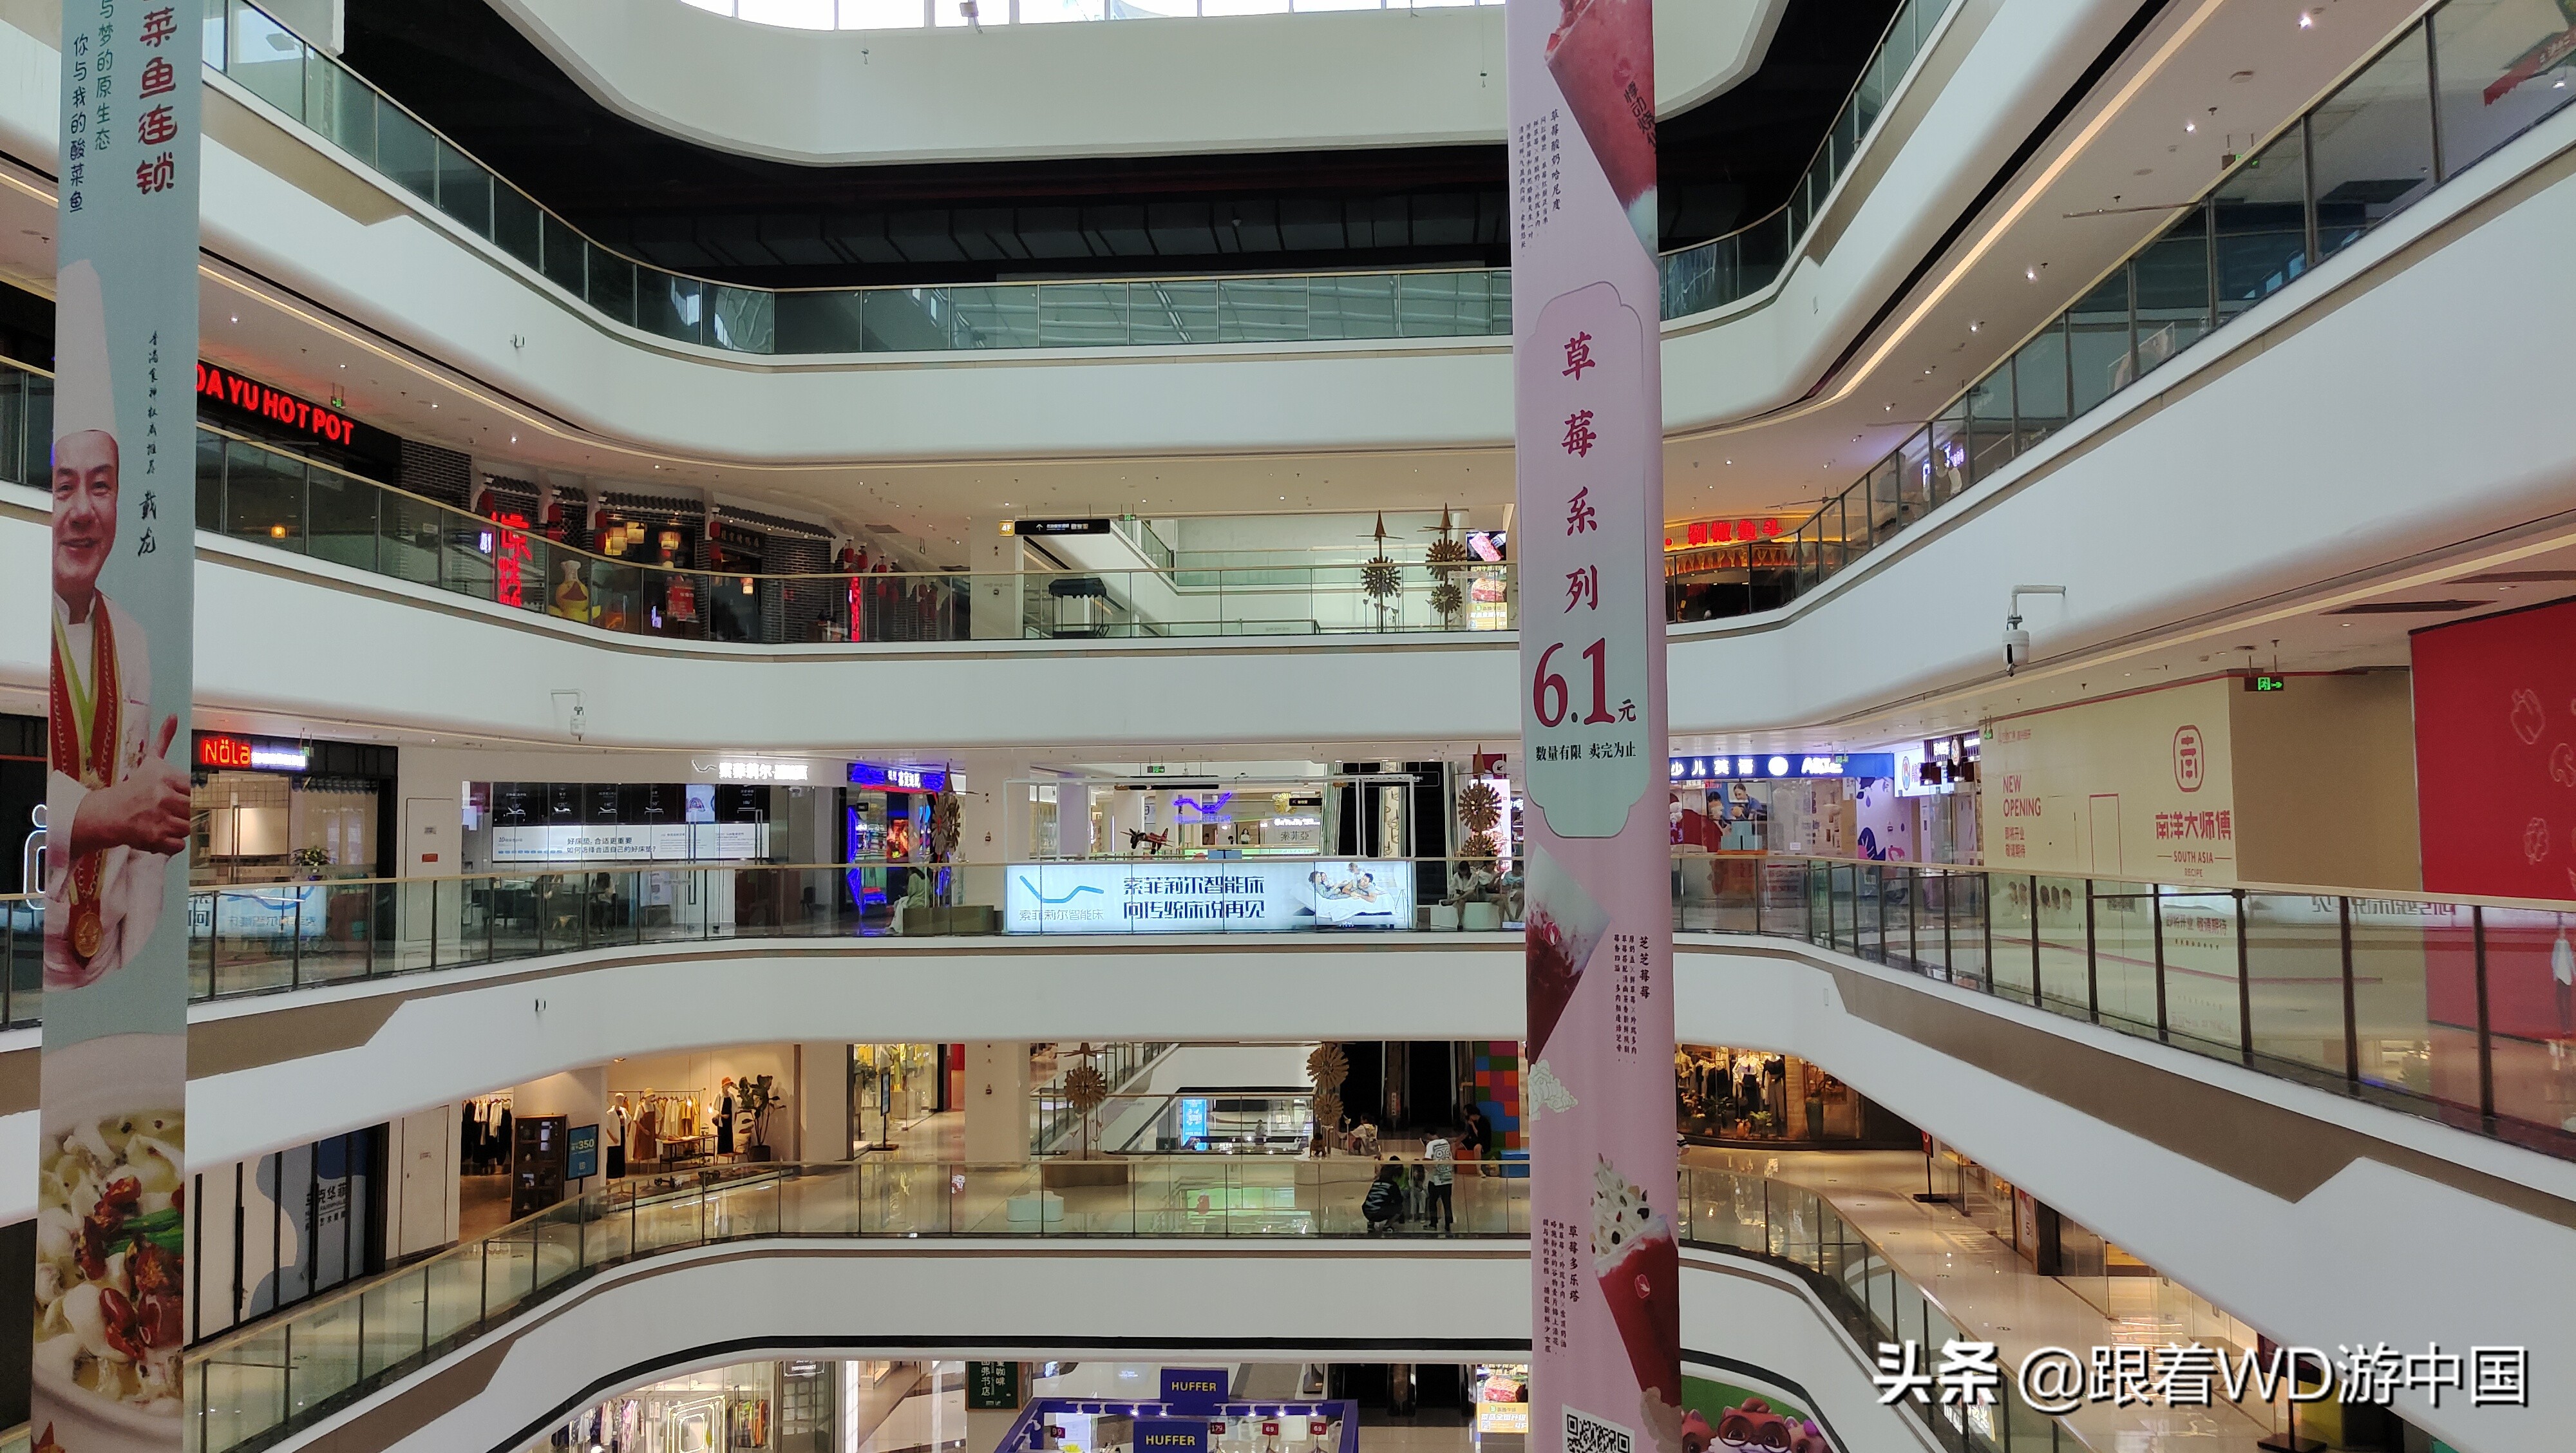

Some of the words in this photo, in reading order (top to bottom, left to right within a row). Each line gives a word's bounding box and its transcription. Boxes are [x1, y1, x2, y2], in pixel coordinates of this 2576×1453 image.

[137, 0, 178, 195] 菜鱼连锁
[68, 33, 89, 214] 你与我的酸菜鱼
[227, 375, 260, 412] YU
[263, 389, 310, 429] HOT
[312, 409, 355, 445] POT
[1561, 330, 1598, 614] 草莓系列
[1687, 517, 1783, 546] 剁椒鱼头
[1535, 743, 1582, 762] 数量有限
[1588, 741, 1636, 760] 卖完为止
[2002, 775, 2022, 793] NEW
[2002, 797, 2041, 817] OPENING
[2005, 826, 2025, 841] 即将开业
[2155, 810, 2232, 840] 南洋大师傅
[2005, 842, 2026, 859] 敬请期待
[2174, 850, 2195, 864] SOUTH
[2197, 850, 2214, 864] ASIA
[1123, 876, 1265, 895] 索菲莉尔智能床
[1123, 900, 1265, 920] 向传统床说再见
[1639, 935, 1651, 1000] 芝芝莓莓
[1567, 1224, 1580, 1302] 草莓多乐塔
[1171, 1381, 1217, 1392] HUFFER
[1145, 1434, 1196, 1447] HUFFER
